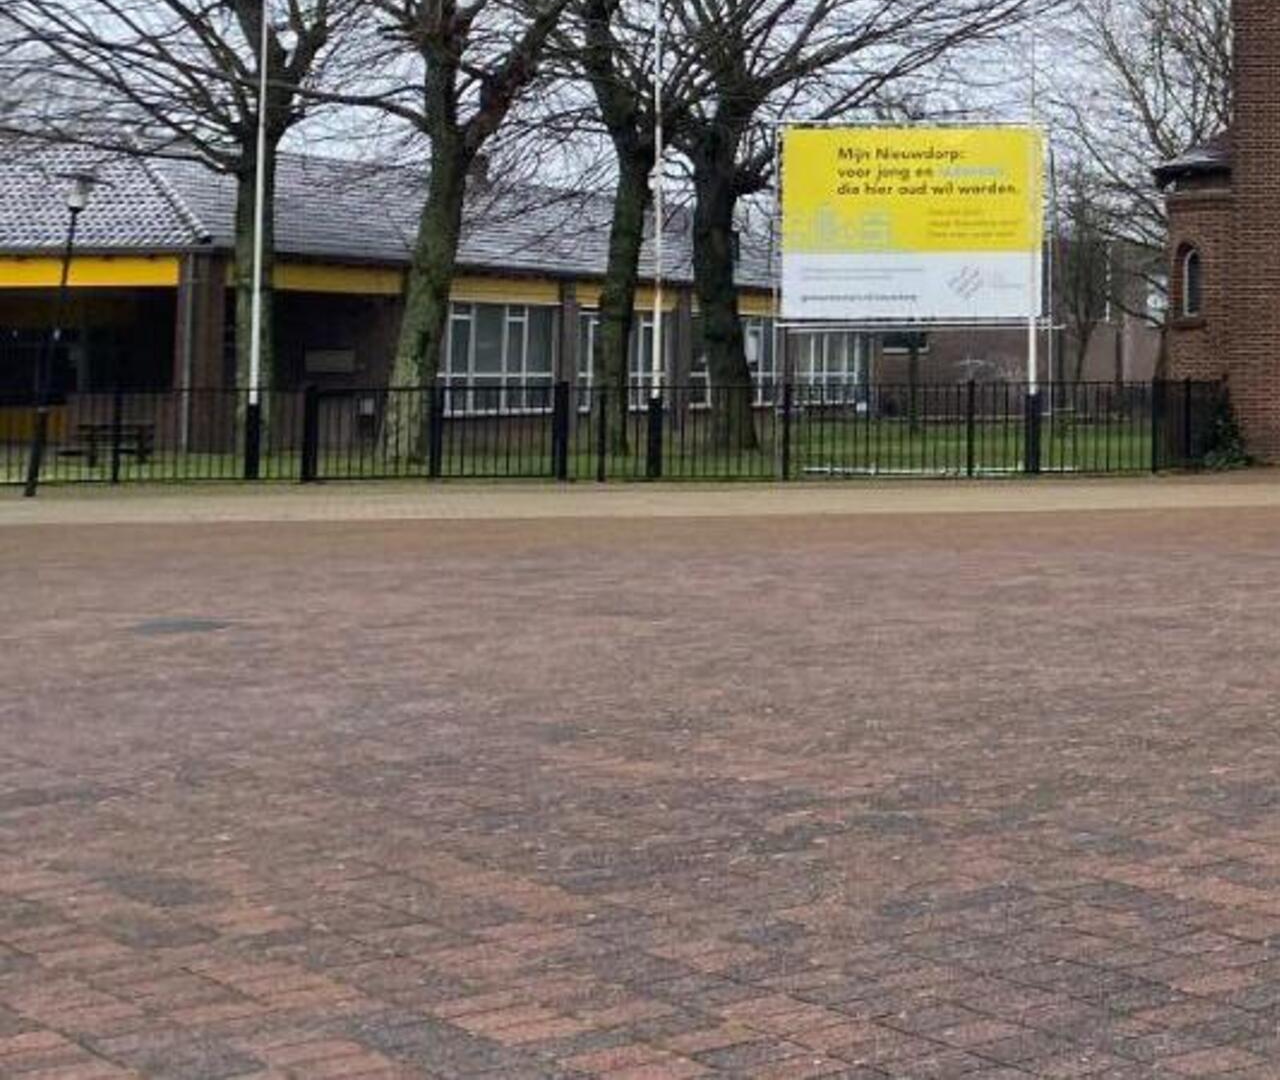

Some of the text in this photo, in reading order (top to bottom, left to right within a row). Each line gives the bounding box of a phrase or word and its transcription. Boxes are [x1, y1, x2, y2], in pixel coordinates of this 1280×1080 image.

[838, 147, 870, 163] Mijn
[837, 167, 872, 179] voor
[876, 165, 911, 182] jong
[915, 168, 934, 179] en
[836, 182, 861, 195] die
[864, 182, 893, 195] hier
[898, 182, 928, 195] oud
[931, 181, 954, 195] wil
